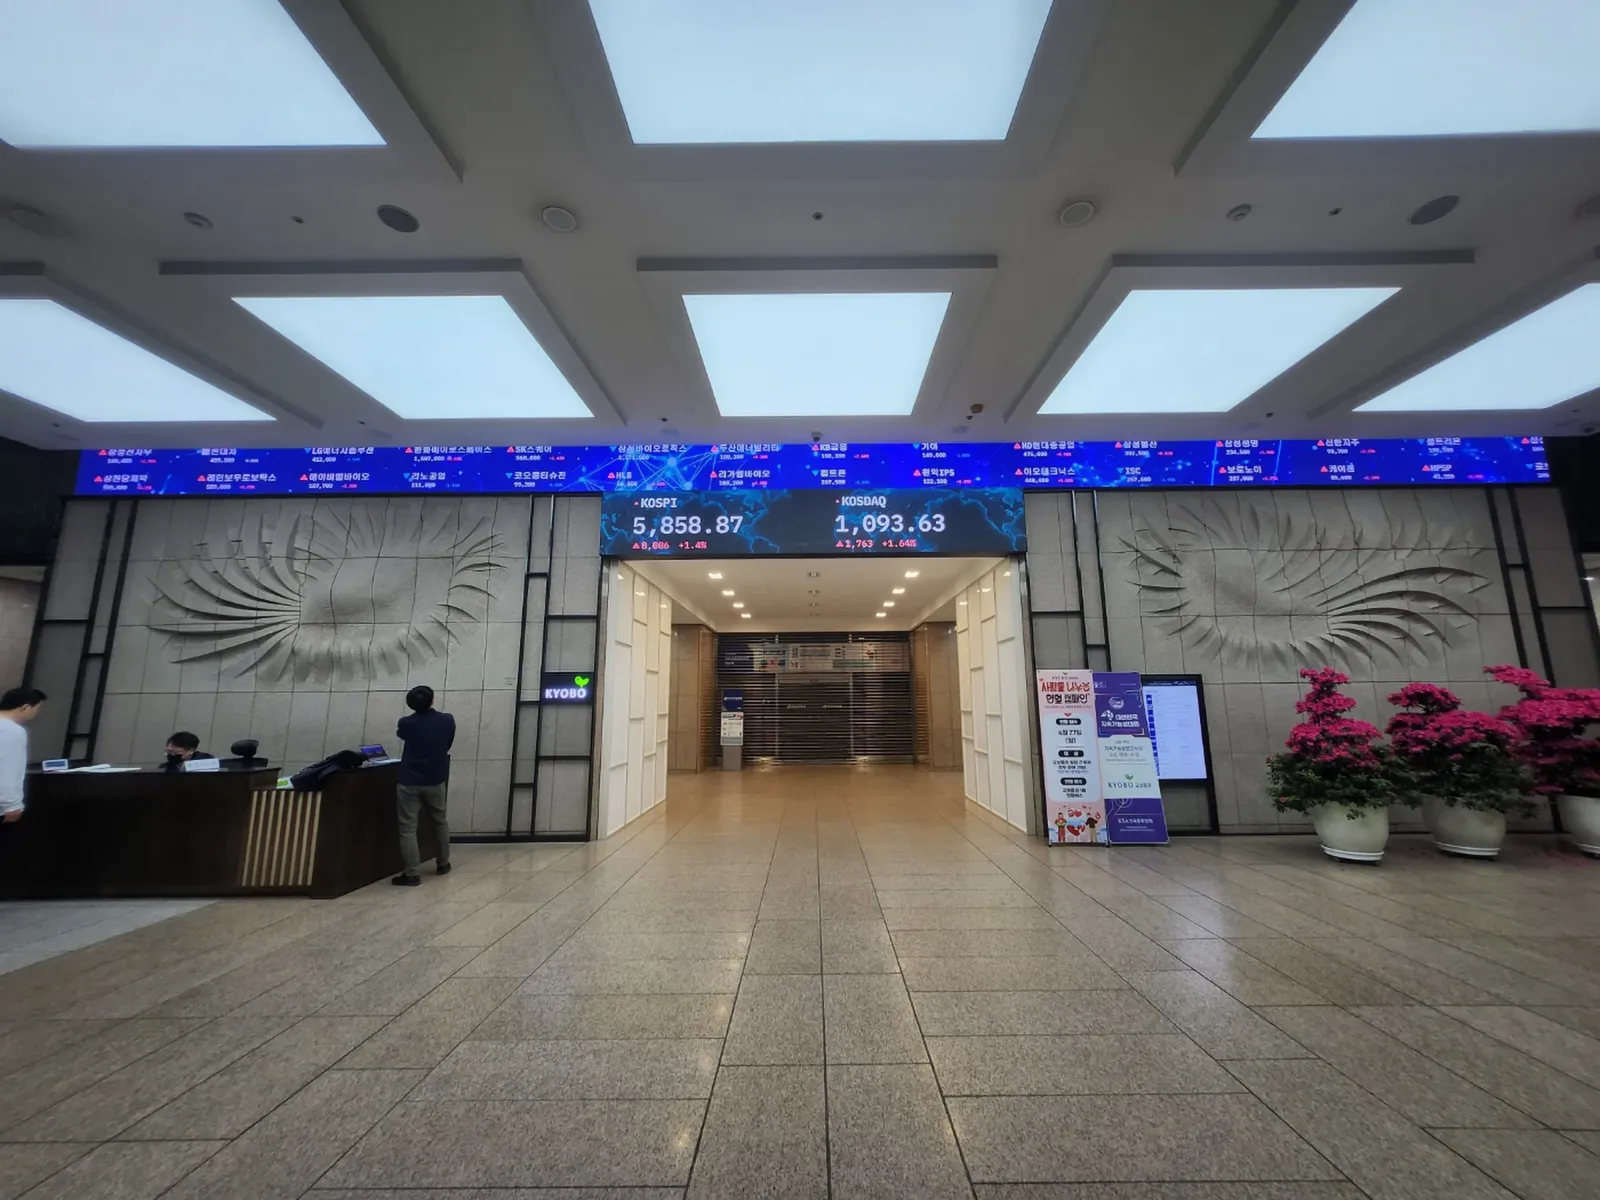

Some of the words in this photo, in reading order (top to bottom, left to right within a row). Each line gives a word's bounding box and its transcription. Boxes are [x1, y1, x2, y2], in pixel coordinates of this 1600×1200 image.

[820, 443, 848, 451] KB금융
[922, 468, 955, 477] 원익IPS
[1023, 467, 1076, 476] 이오테크닉스
[1125, 467, 1141, 475] ISC
[1227, 465, 1262, 474] 보로노이
[411, 472, 446, 480] 리노공업
[616, 471, 632, 479] HLB
[640, 498, 678, 509] KOSPI
[841, 496, 887, 508] KOSDAQ
[633, 515, 744, 538] 5,858.87
[835, 513, 946, 536] 1,093.63
[641, 541, 670, 550] 8,086
[678, 541, 708, 550] +1.4%
[845, 539, 874, 549] 1,763
[881, 539, 917, 548] +1.64%
[545, 688, 587, 699] KYOBO
[1046, 693, 1063, 704] 헌혈
